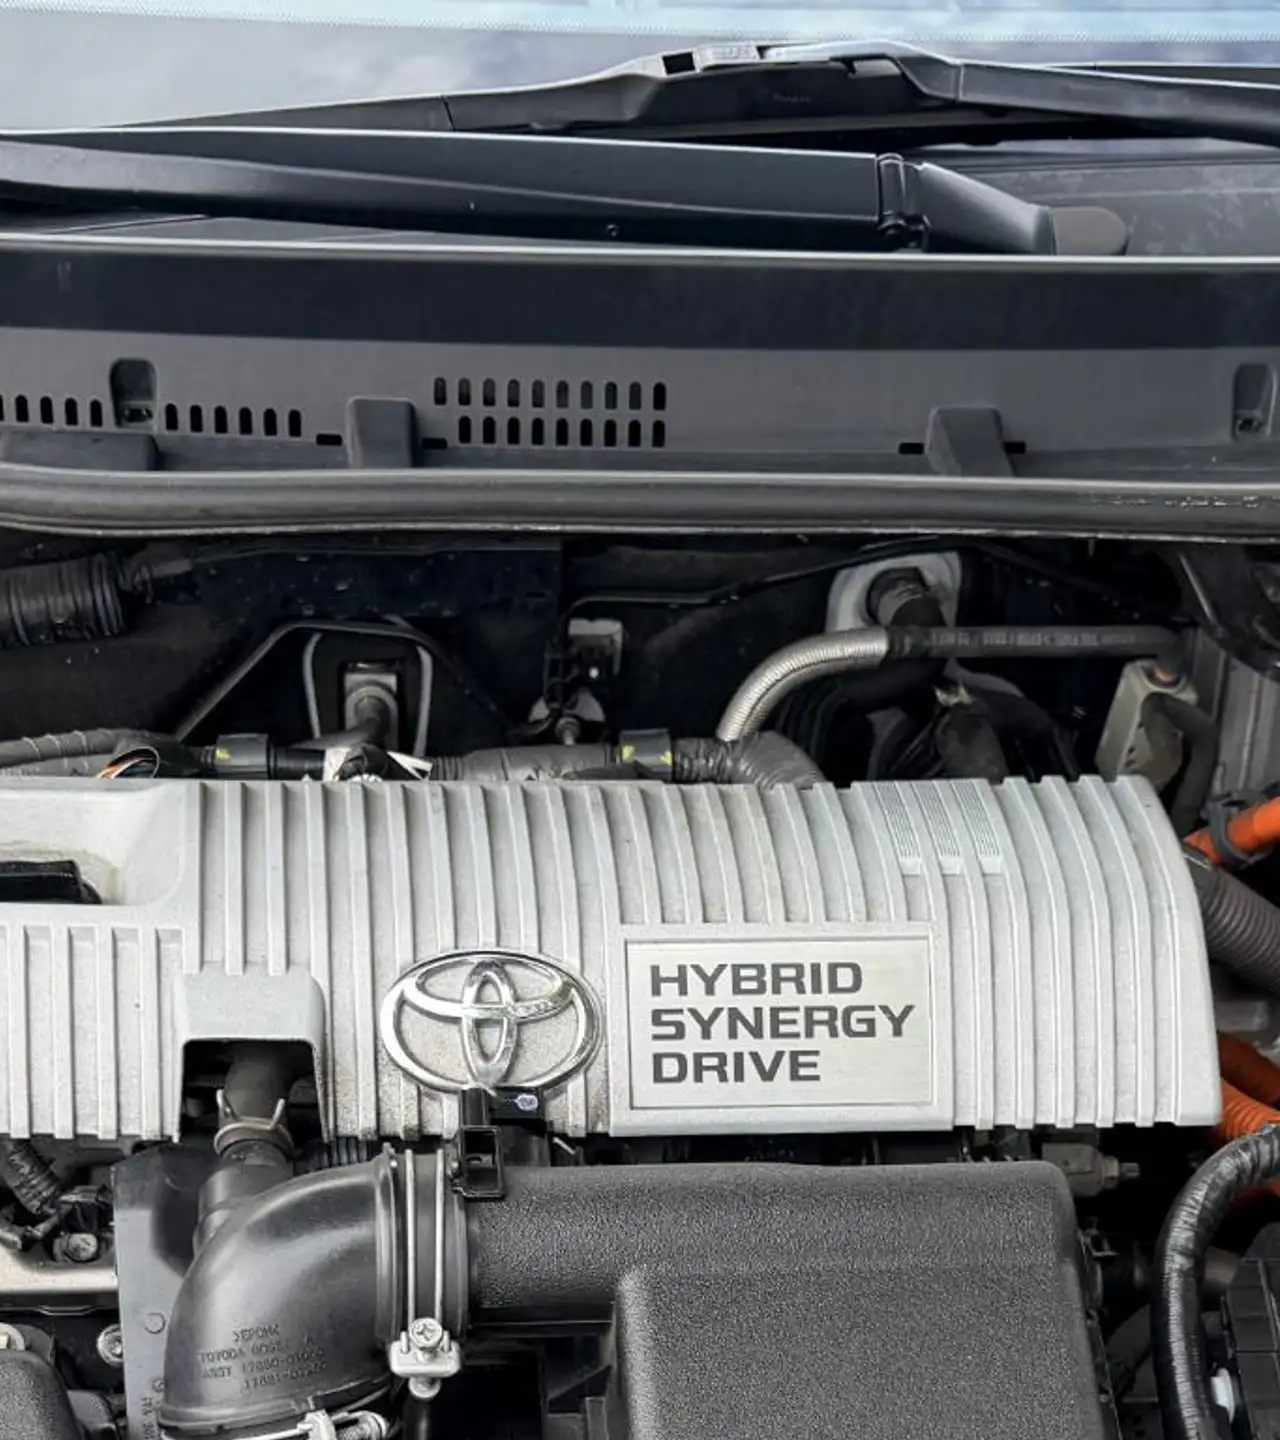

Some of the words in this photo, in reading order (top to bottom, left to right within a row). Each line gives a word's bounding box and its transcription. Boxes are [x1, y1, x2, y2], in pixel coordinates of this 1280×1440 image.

[649, 962, 863, 996] HYBRID
[650, 1004, 915, 1041] SYNERGY
[651, 1050, 822, 1083] DRIVE
